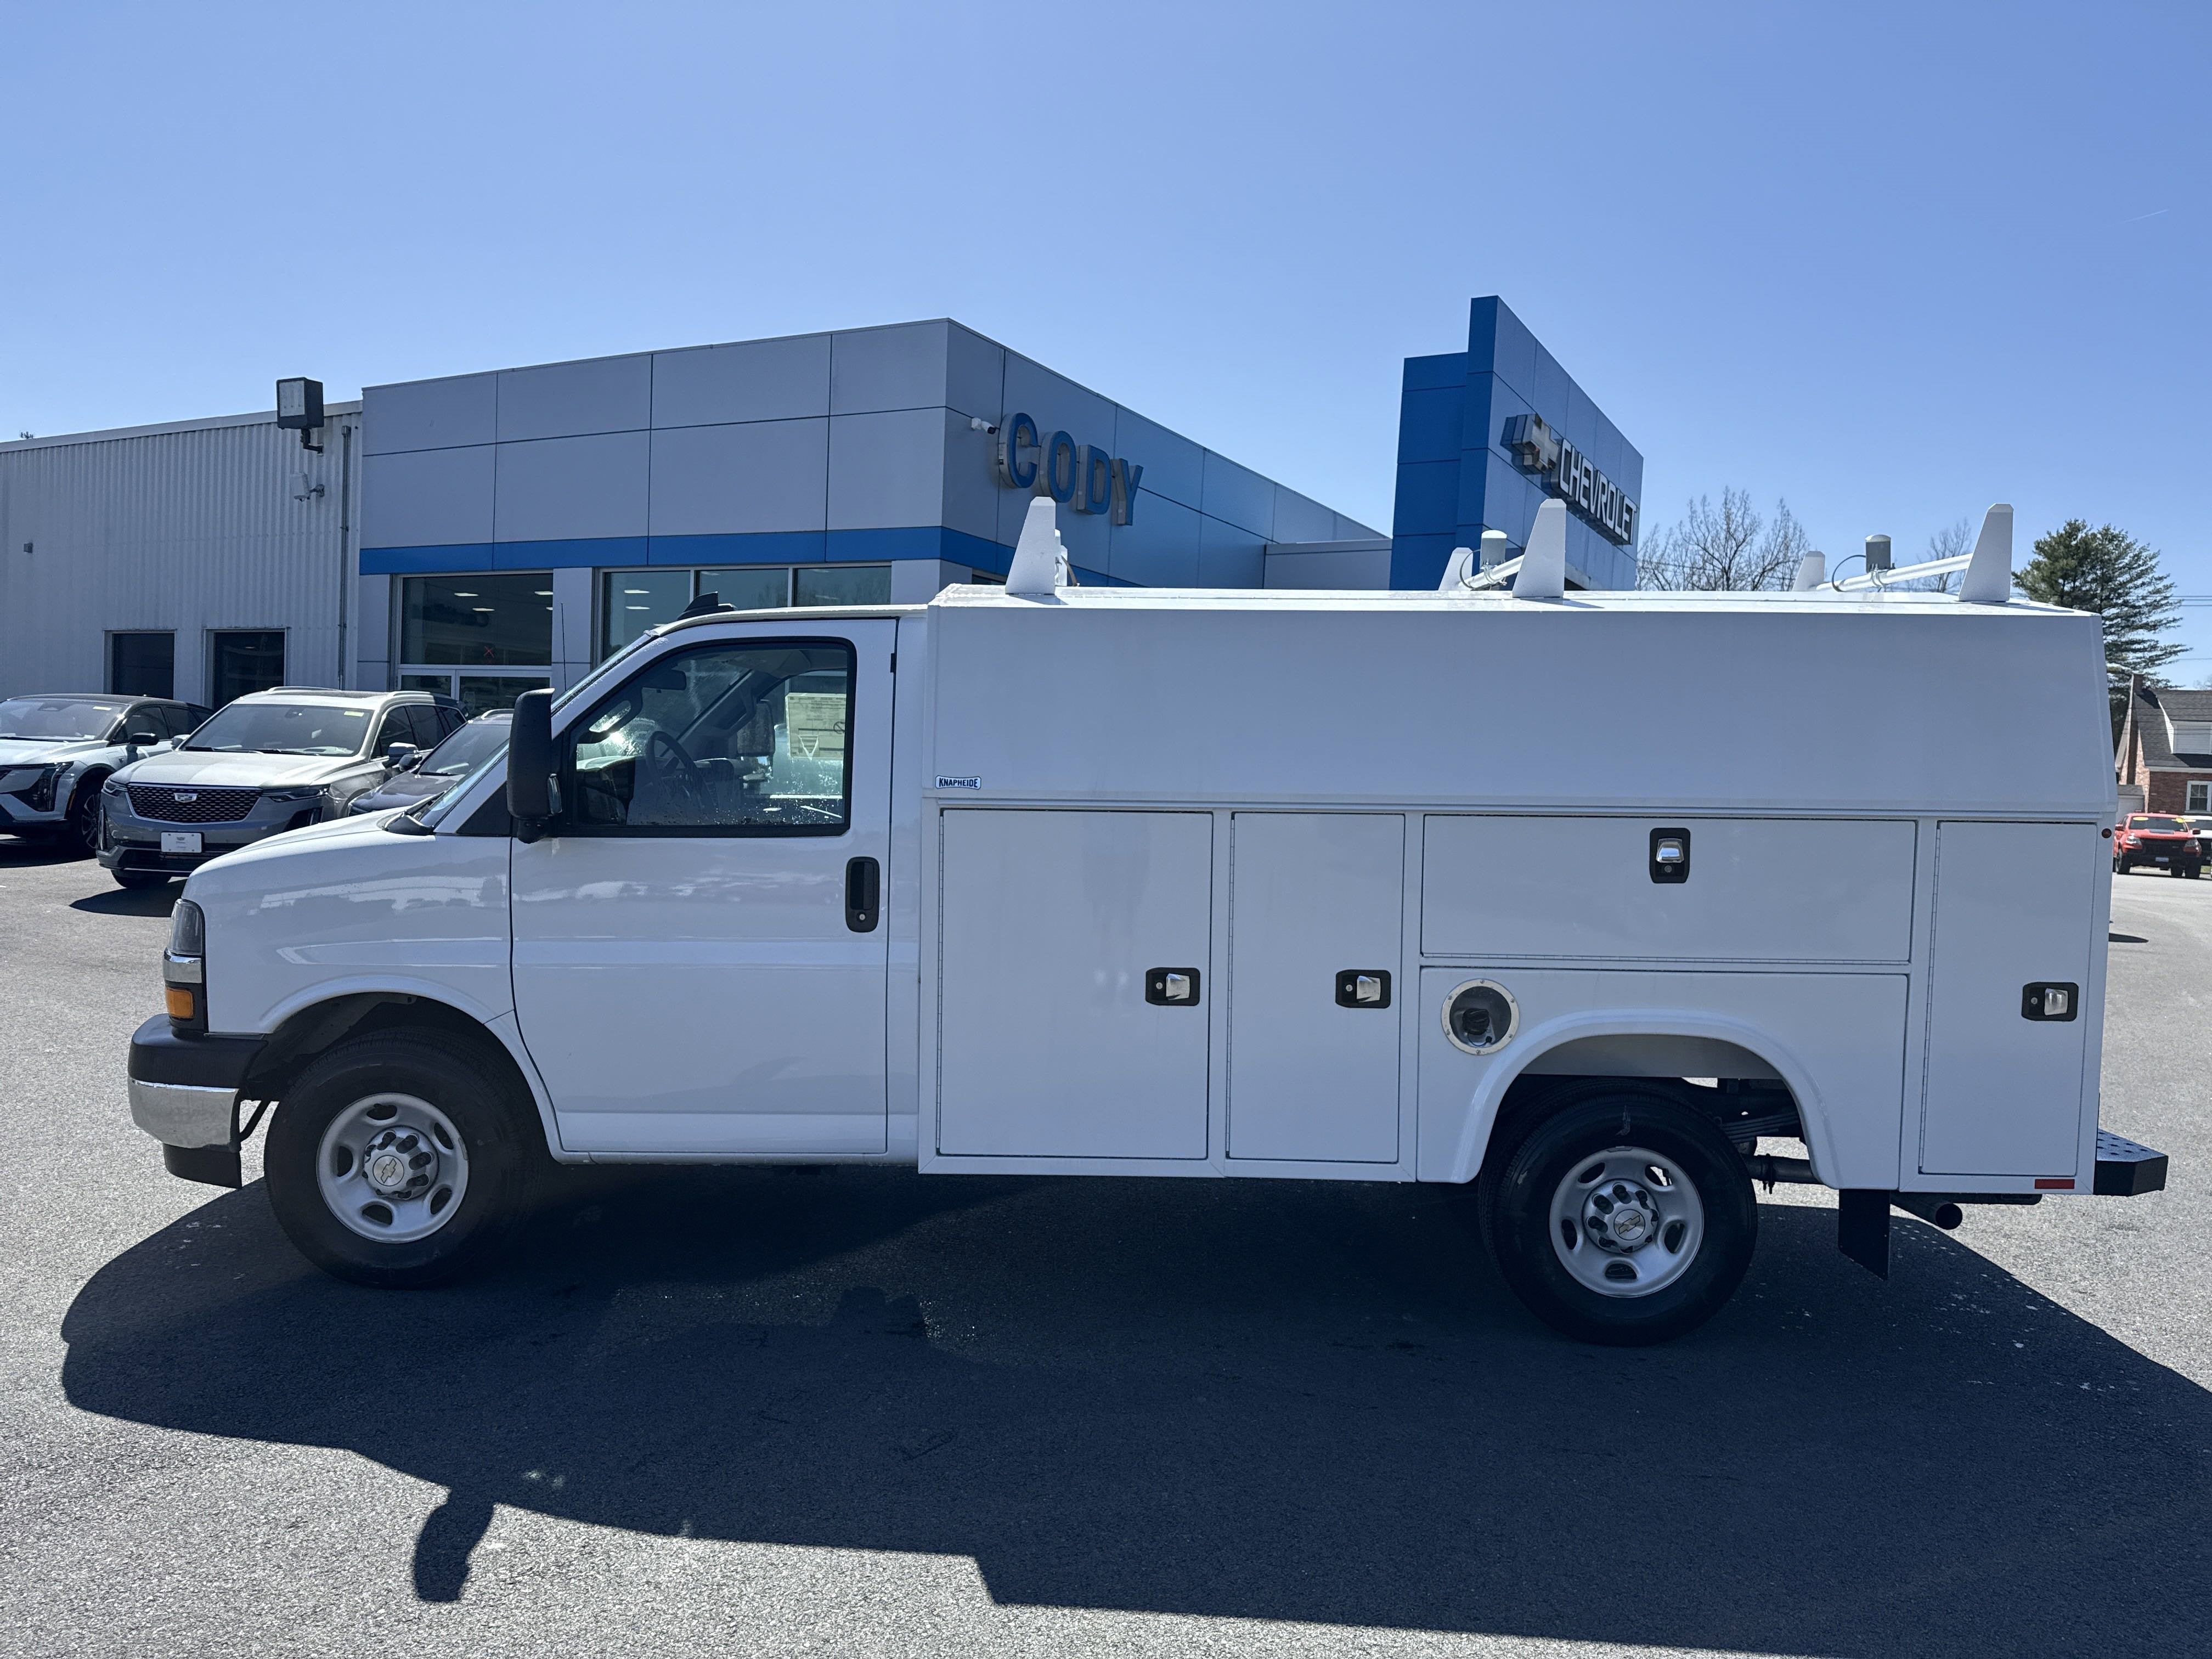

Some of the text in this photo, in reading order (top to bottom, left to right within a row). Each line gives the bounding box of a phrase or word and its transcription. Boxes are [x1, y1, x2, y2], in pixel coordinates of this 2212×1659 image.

[1000, 413, 1143, 526] CODY
[1559, 438, 1637, 545] CHEVROLET
[939, 777, 978, 788] KNAPHEIDE
